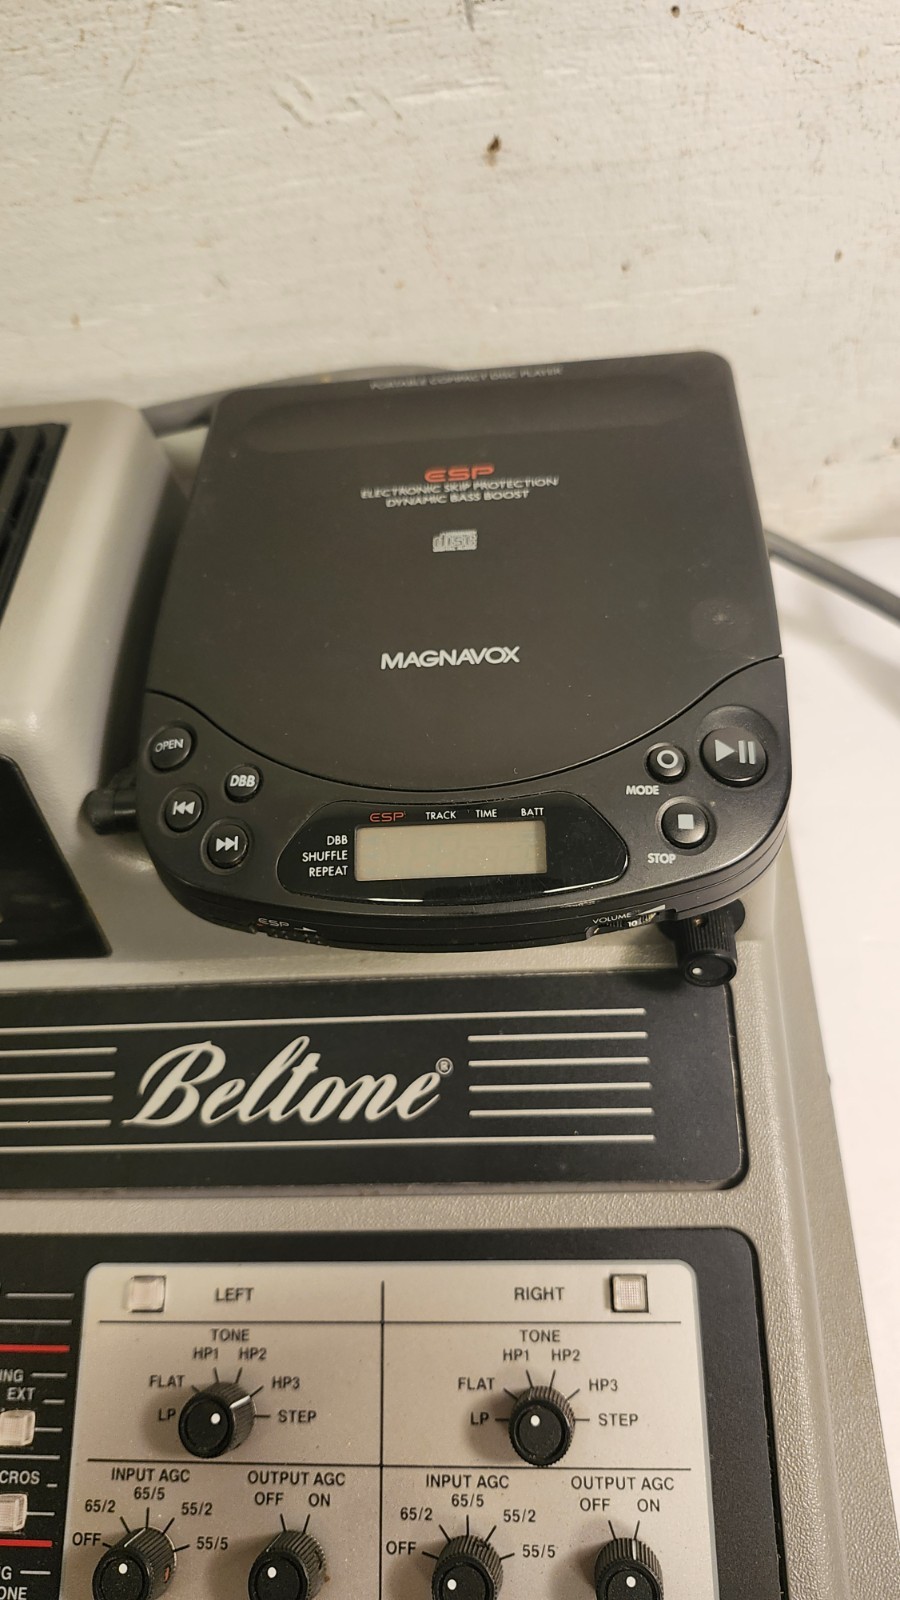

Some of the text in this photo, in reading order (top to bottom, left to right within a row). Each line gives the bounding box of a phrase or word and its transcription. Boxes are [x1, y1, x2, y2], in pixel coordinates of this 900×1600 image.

[424, 464, 495, 483] ESP
[360, 476, 560, 499] ELECTRONIC SKIP PROTECTION
[385, 490, 530, 508] DYNAMIC BASS BOOST
[380, 646, 520, 670] MAGNAVOX
[155, 738, 184, 753] OPEN
[229, 774, 256, 787] DBB
[625, 785, 660, 796] MODE
[369, 811, 406, 823] ESP
[425, 810, 457, 820] TRACK
[476, 808, 498, 818] TIME
[520, 807, 544, 817] BATT
[326, 834, 348, 846] DBB
[302, 850, 348, 863] SHUFFLE
[647, 853, 676, 864] STOP
[308, 865, 349, 878] REPEAT
[257, 917, 290, 928] ESP
[592, 912, 632, 924] VOLUME
[215, 1287, 254, 1302] LEFT
[513, 1286, 565, 1302] RIGHT
[211, 1328, 251, 1342] TONE
[520, 1329, 561, 1343] TONE
[192, 1347, 219, 1361] HP1
[238, 1347, 267, 1361] HP2
[502, 1348, 529, 1361] HP1
[551, 1348, 581, 1362] HP2
[149, 1374, 185, 1388] FLAT
[272, 1376, 300, 1390] HP3
[457, 1377, 495, 1391] FLAT
[588, 1378, 618, 1392] HP3
[7, 1386, 36, 1400] EXT
[157, 1408, 176, 1422] LP
[278, 1409, 317, 1423] STEP
[469, 1412, 489, 1426] LP
[598, 1413, 639, 1427] STEP
[111, 1467, 191, 1483] INPUT AGC
[247, 1470, 346, 1487] OUTPUT AGC
[425, 1474, 510, 1489] INPUT AGC
[570, 1475, 675, 1492] OUTPUT AGC
[133, 1486, 166, 1500] 65/5
[254, 1491, 284, 1506] OFF
[308, 1492, 331, 1507] ON
[84, 1499, 116, 1513] 65/2
[451, 1493, 484, 1508] 65/5
[579, 1497, 611, 1512] OFF
[636, 1498, 660, 1513] ON
[181, 1502, 213, 1516] 55/2
[400, 1506, 433, 1521] 65/2
[502, 1508, 536, 1523] 55/2
[72, 1532, 102, 1546] OFF
[196, 1536, 229, 1551] 55/5
[385, 1540, 417, 1555] OFF
[522, 1544, 556, 1559] 55/5
[0, 1566, 12, 1580] G
